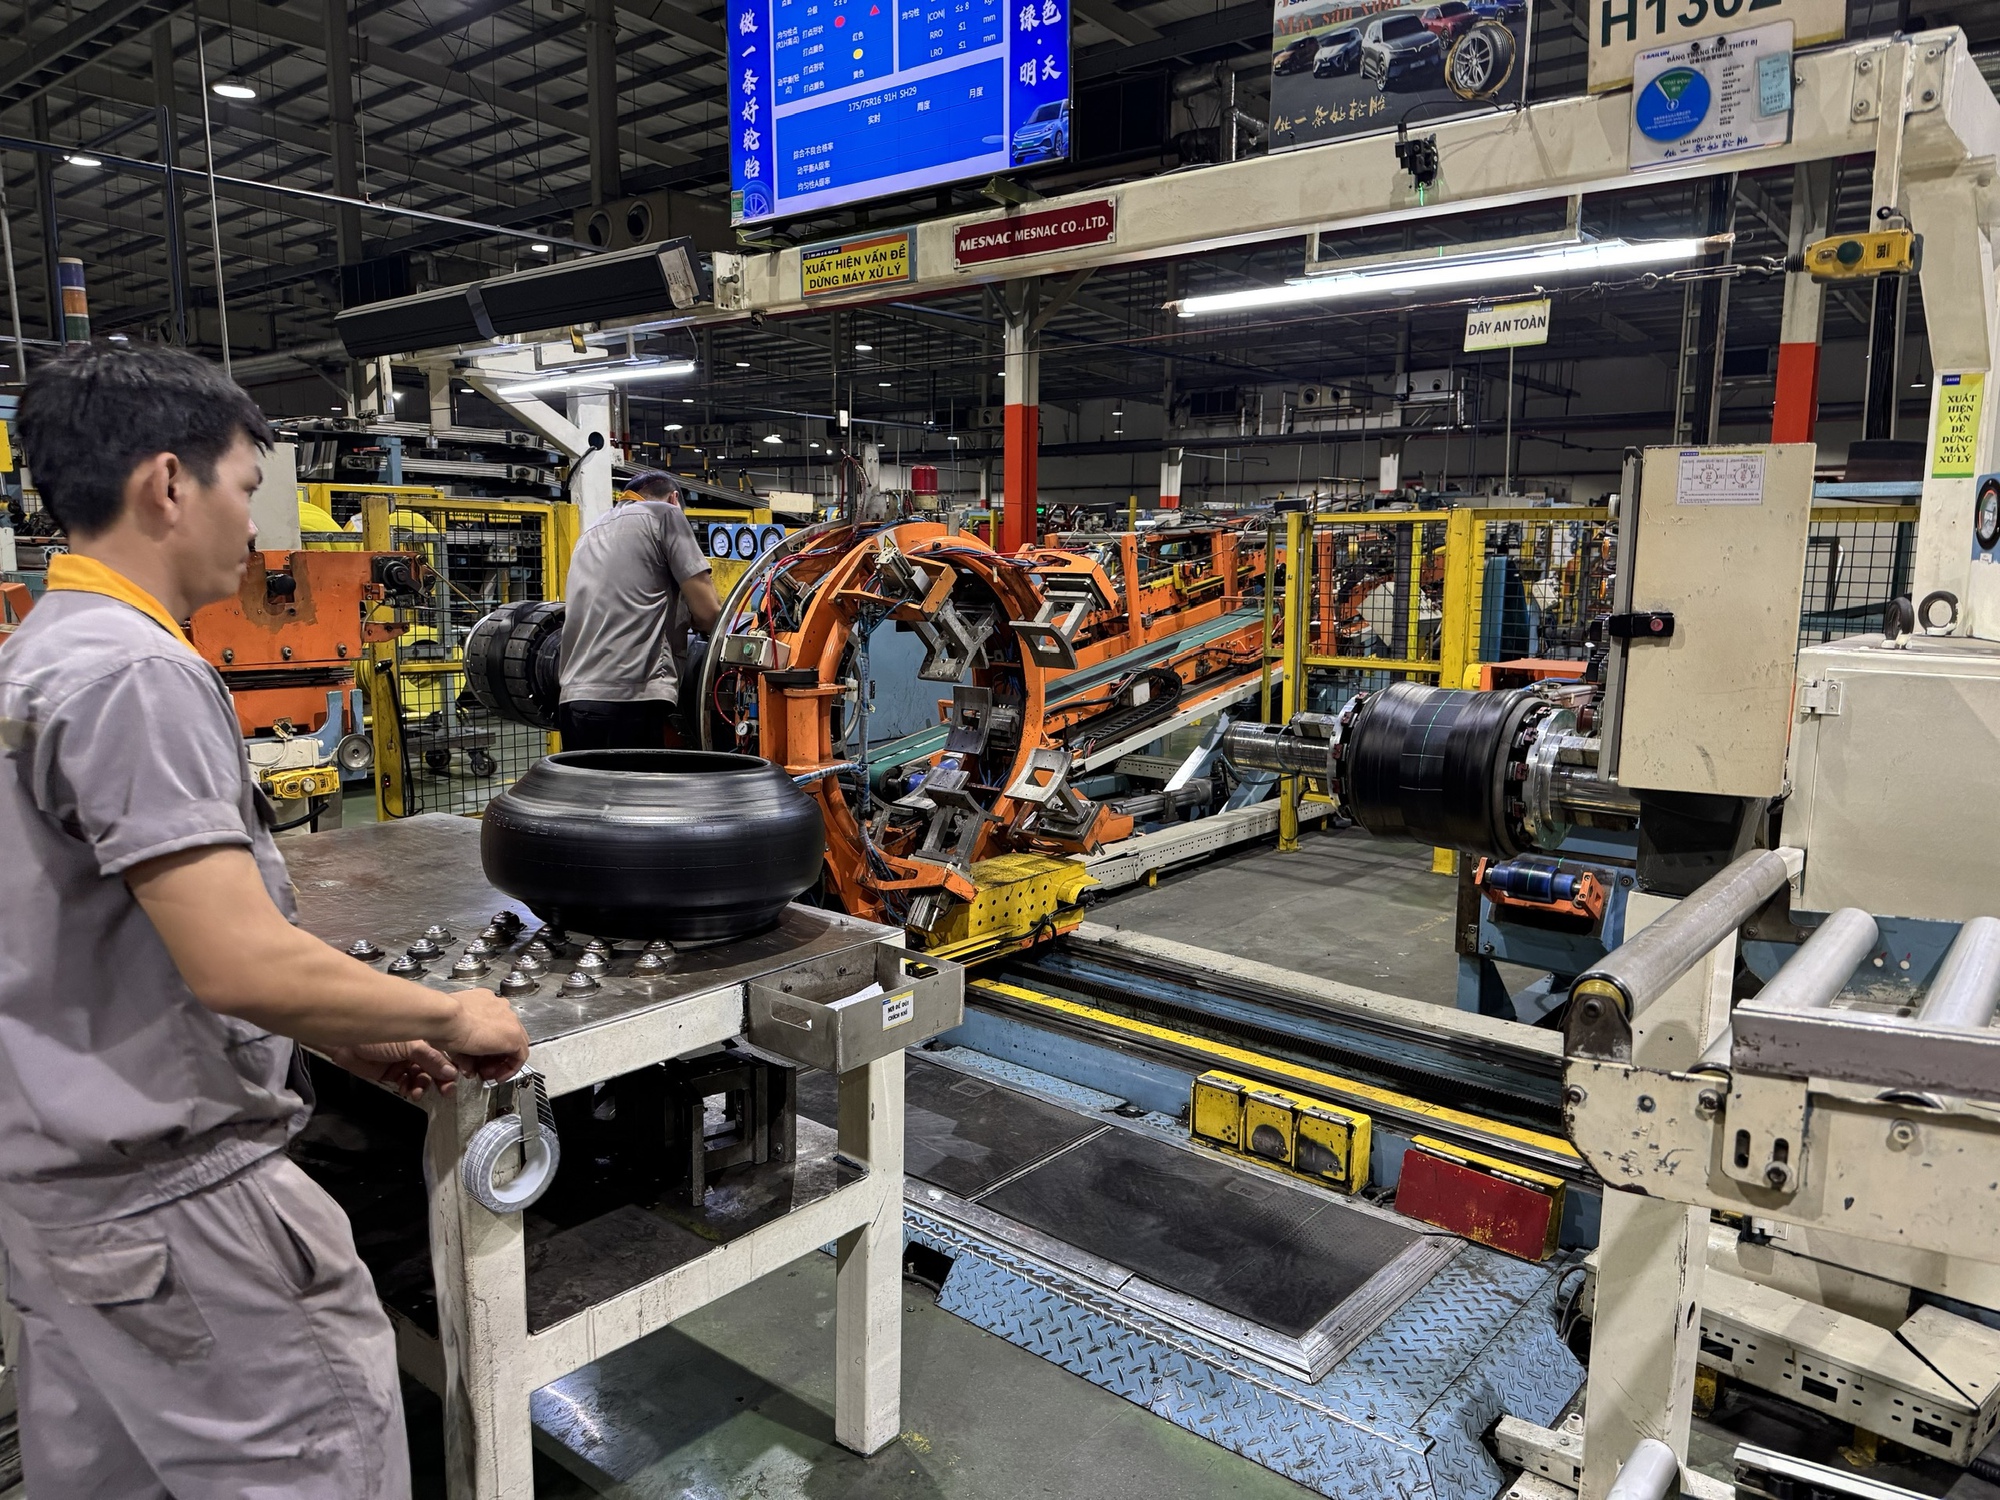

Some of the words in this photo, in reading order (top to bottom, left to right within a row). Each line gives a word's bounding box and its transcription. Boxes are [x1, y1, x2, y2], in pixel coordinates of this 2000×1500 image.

[739, 9, 761, 180] 做一条好轮胎
[884, 91, 898, 104] 91H
[900, 86, 918, 100] SH29
[959, 231, 1012, 252] MESNAC
[1014, 222, 1058, 242] MESNAC
[805, 256, 833, 276] XUẤT
[836, 254, 860, 272] HIỆN
[864, 248, 887, 265] VẤN
[810, 270, 840, 289] DỪNG
[842, 265, 866, 284] MÁY
[868, 262, 884, 280] XỬ
[888, 260, 902, 276] LÝ
[1468, 321, 1492, 336] DÂY
[1494, 320, 1511, 333] AN
[1514, 314, 1546, 330] TOÀN
